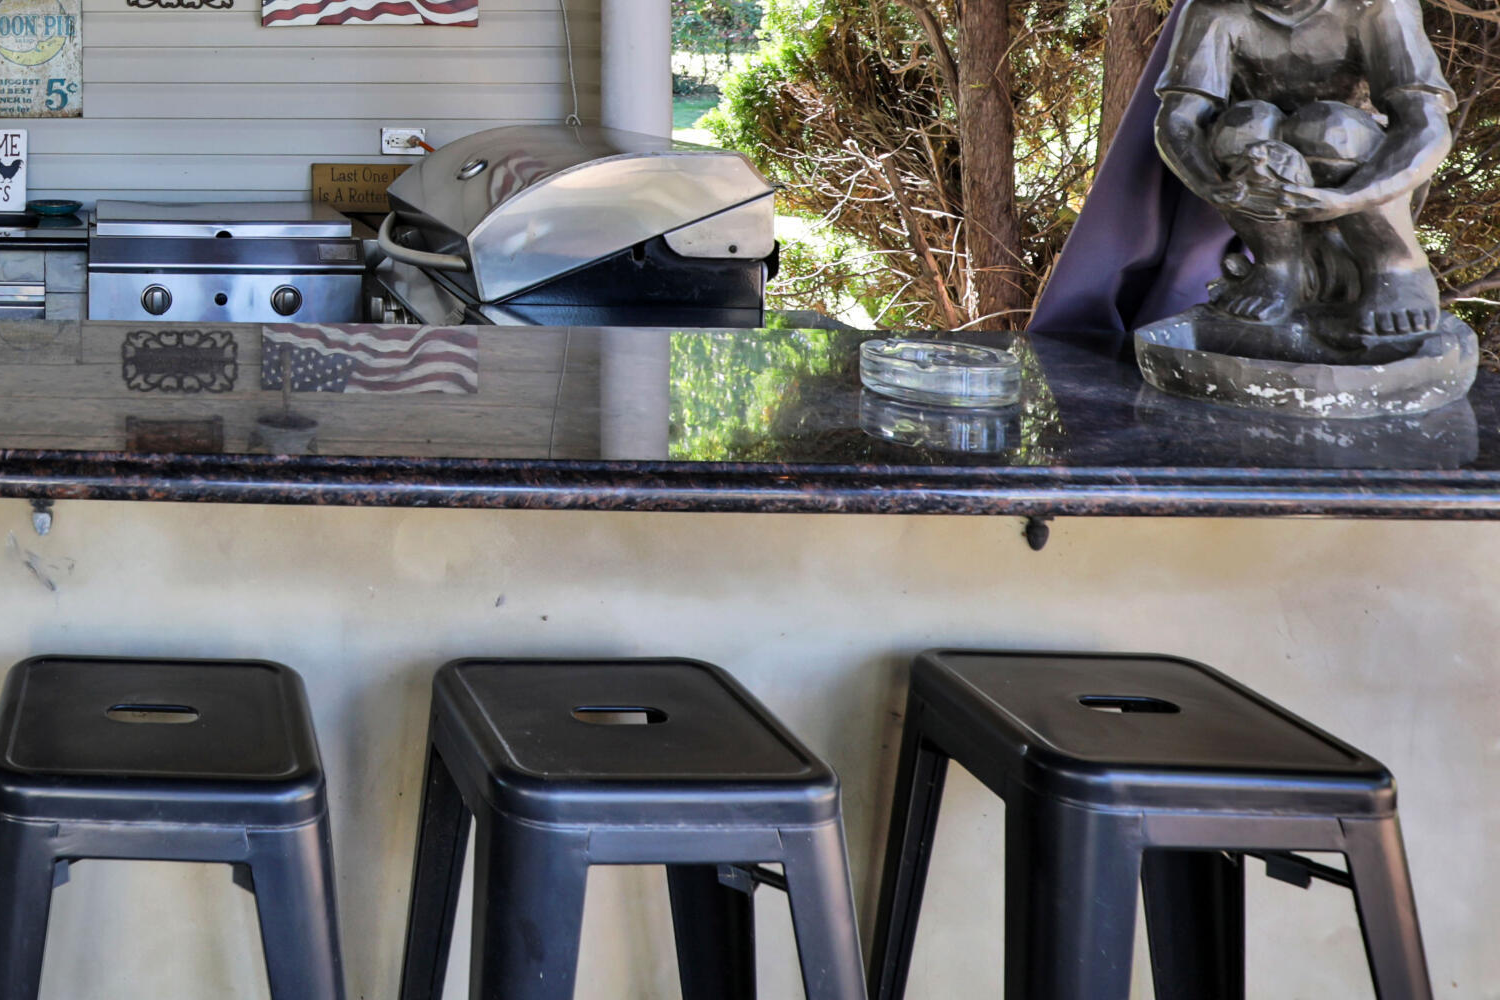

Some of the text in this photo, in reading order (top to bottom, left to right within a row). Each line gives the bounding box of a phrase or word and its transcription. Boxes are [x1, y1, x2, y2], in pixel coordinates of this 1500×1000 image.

[44, 15, 76, 36] PIE
[331, 167, 357, 182] Last
[362, 167, 388, 183] One
[318, 187, 330, 202] Is
[334, 187, 343, 203] A
